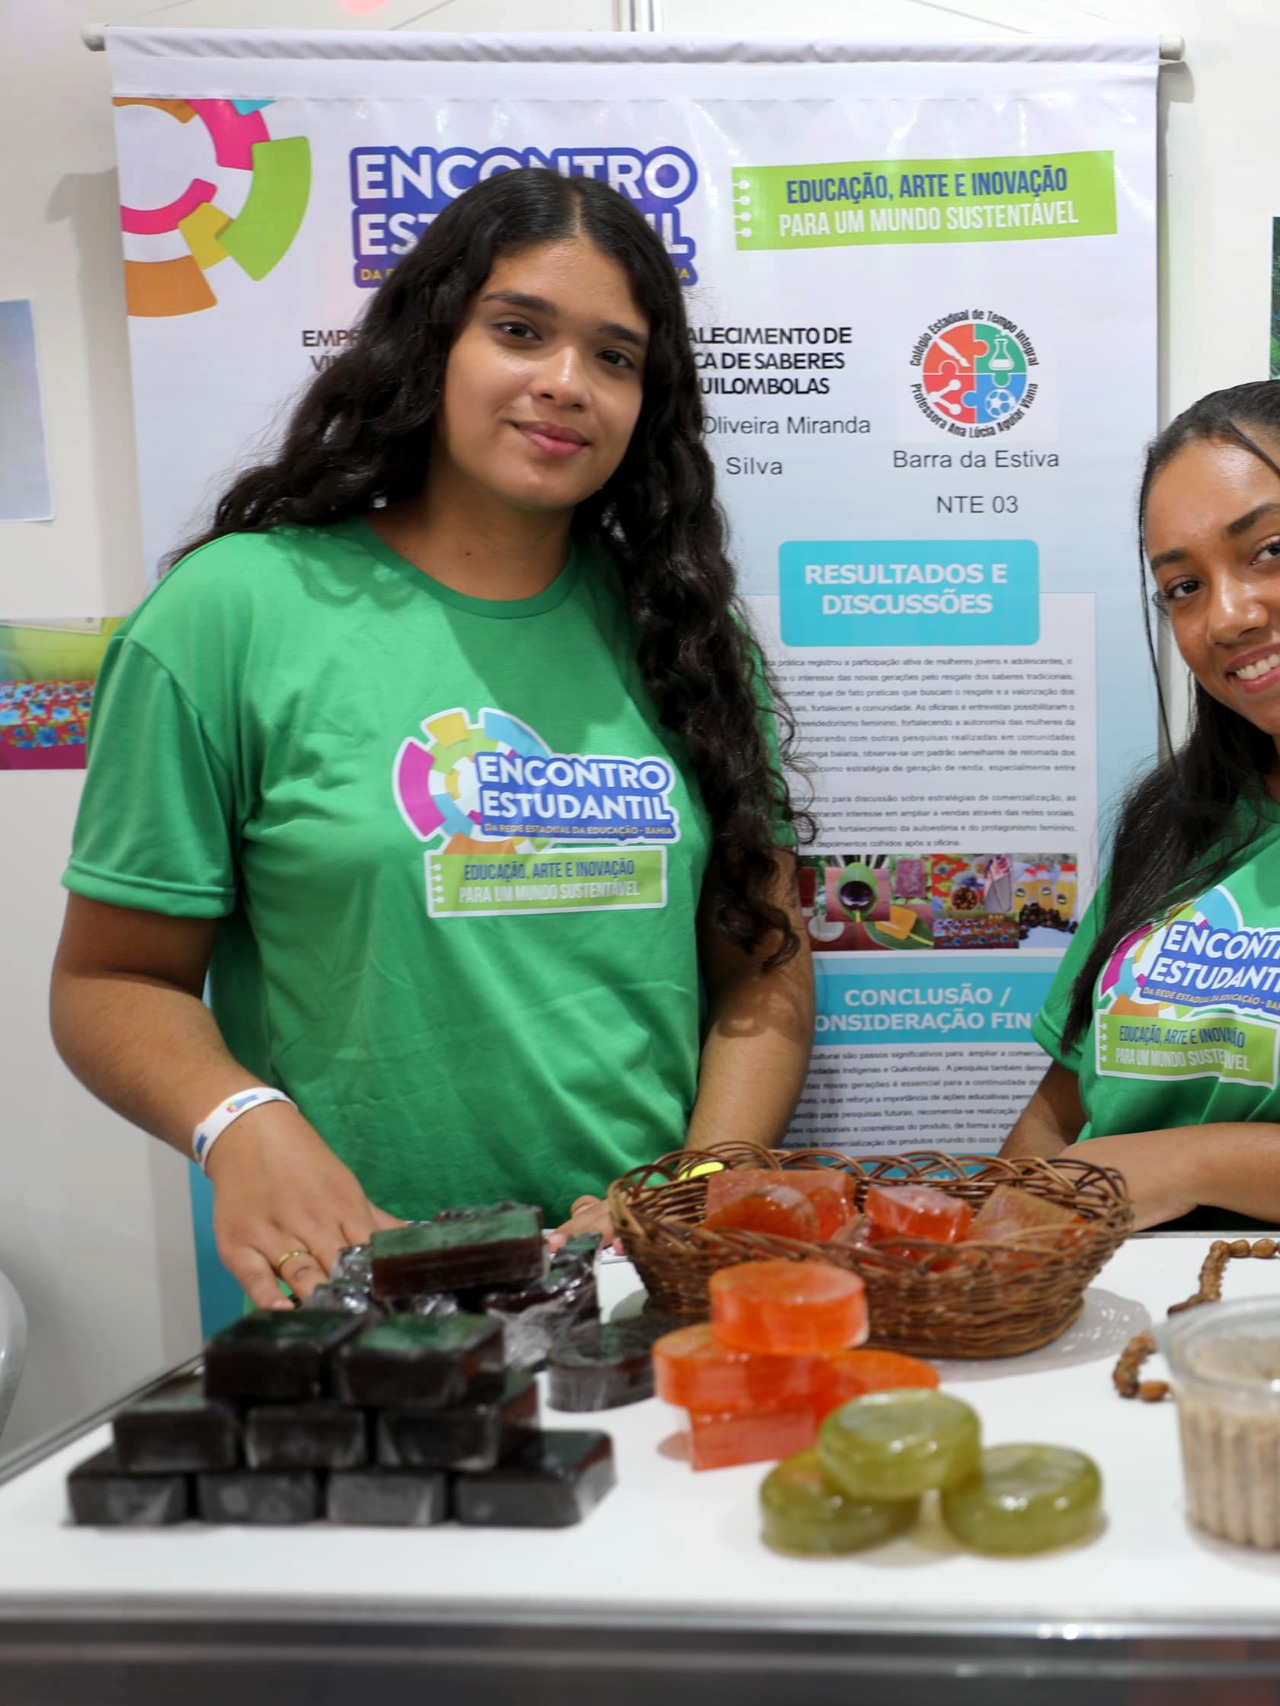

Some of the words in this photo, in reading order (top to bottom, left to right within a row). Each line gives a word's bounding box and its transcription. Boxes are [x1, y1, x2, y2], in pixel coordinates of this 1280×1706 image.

[787, 171, 895, 206] EDUCAÇÃO,
[900, 172, 949, 198] ARTE
[954, 173, 966, 197] E
[972, 165, 1068, 198] INOVAÇÃO
[779, 211, 830, 238] PARA
[835, 209, 865, 234] UM
[870, 207, 941, 232] MUNDO
[946, 198, 1079, 230] SUSTENTÁVEL
[360, 268, 383, 281] DA
[823, 327, 853, 345] DE
[927, 310, 970, 335] Estadual
[972, 309, 984, 320] de
[987, 311, 1018, 334] Tempo
[1014, 329, 1040, 367] Integral
[722, 352, 751, 370] DE
[754, 352, 845, 370] SABERES
[701, 377, 830, 395] UILOMBOLAS
[910, 383, 948, 429] Professora
[947, 422, 966, 437] Ana
[969, 425, 996, 438] Lúcia
[702, 415, 780, 435] Oliveira
[787, 415, 871, 434] Miranda
[726, 456, 783, 475] Silva
[893, 450, 952, 469] Barra
[960, 450, 987, 469] da
[995, 449, 1060, 469] Estiva
[936, 495, 985, 514] NTE
[991, 495, 1020, 514] 03
[805, 563, 985, 585] RESULTADOS
[992, 563, 1008, 584] E
[822, 588, 994, 616] DISCUSSÕES
[477, 755, 667, 790] ENCONTRO
[481, 789, 671, 820] ESTUDANTIL
[532, 862, 562, 879] ARTE
[565, 862, 573, 878] E
[575, 858, 635, 879] INOVAÇÃO
[459, 886, 490, 904] PARA
[494, 886, 513, 902] UM
[515, 884, 558, 901] MUNDO
[560, 880, 641, 900] SUSTENTÁVEL
[844, 983, 993, 1007] CONCLUSÃO
[815, 1009, 985, 1033] ONSIDERAÇÃO
[991, 1011, 1036, 1029] FIN
[1164, 1028, 1187, 1045] ARTE
[1190, 1029, 1198, 1045] E
[1115, 1047, 1135, 1065] PARA
[1136, 1050, 1150, 1066] UM
[1150, 1050, 1187, 1067] MUNDO
